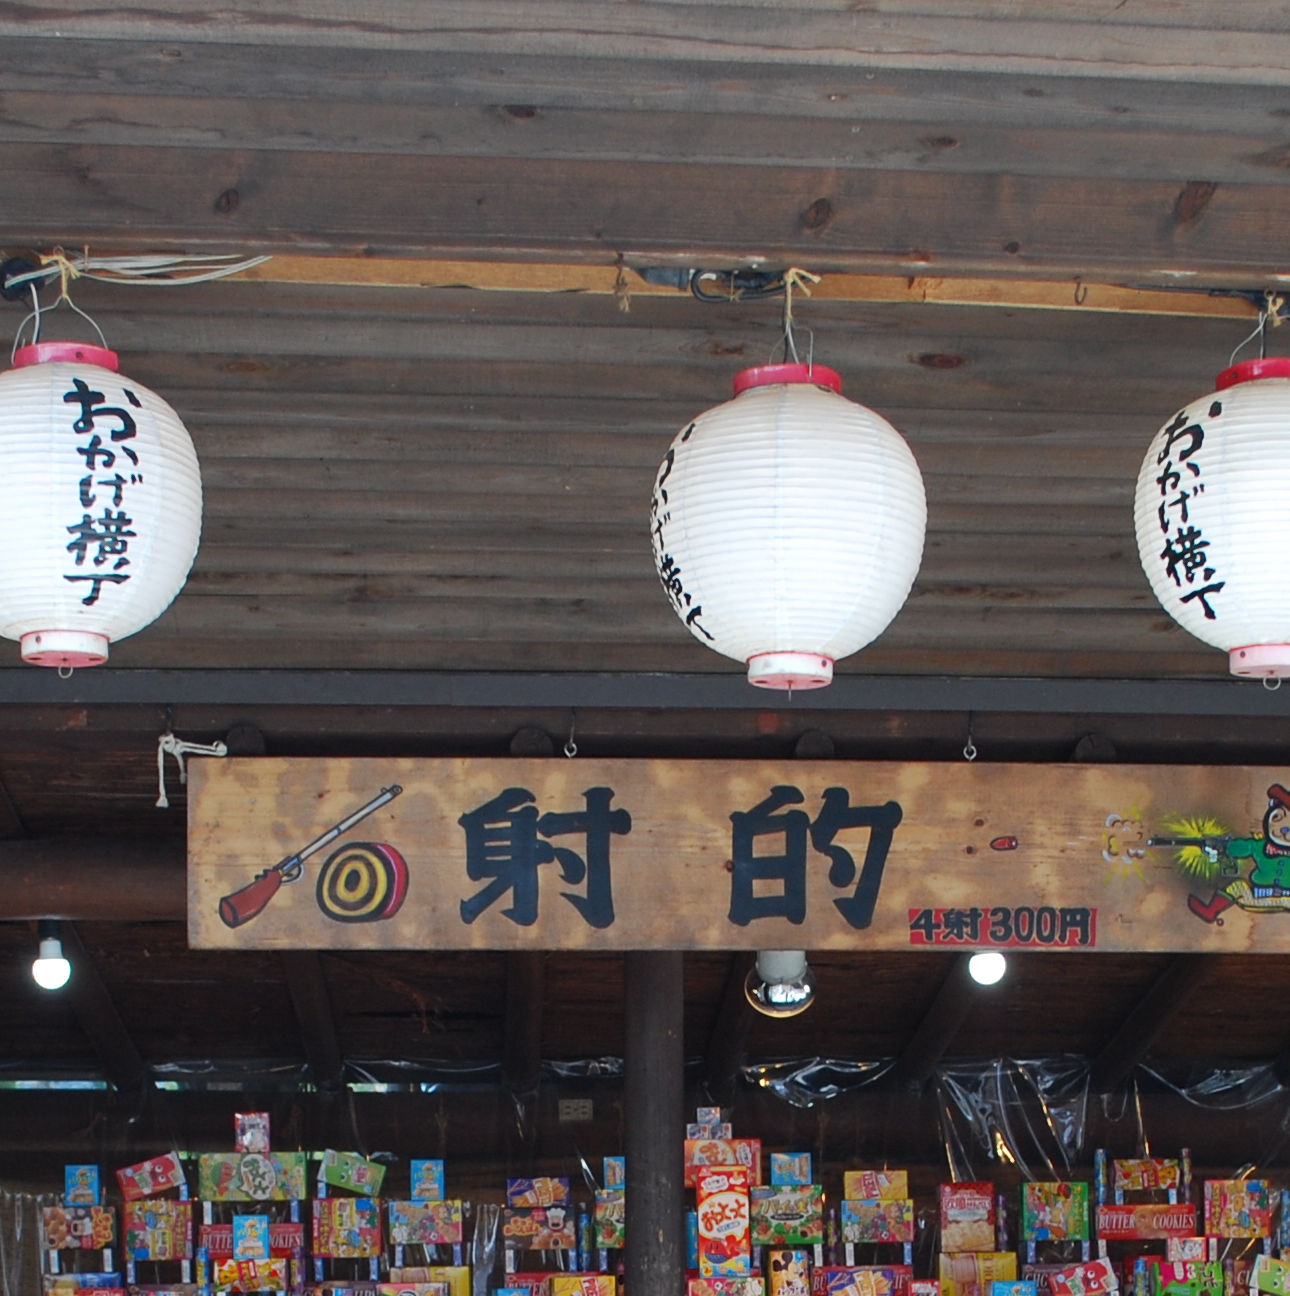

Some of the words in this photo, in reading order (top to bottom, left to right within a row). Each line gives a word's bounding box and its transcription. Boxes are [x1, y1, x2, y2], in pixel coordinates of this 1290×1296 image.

[64, 378, 143, 606] おかげ横丁
[1156, 401, 1226, 620] おかげ横丁
[458, 785, 903, 929] 射的
[701, 1199, 746, 1231] おっとっと
[1099, 1215, 1135, 1229] BUTTER
[1152, 1215, 1195, 1229] COOKIES
[202, 1234, 233, 1249] BUTTE
[983, 1254, 994, 1282] OICE
